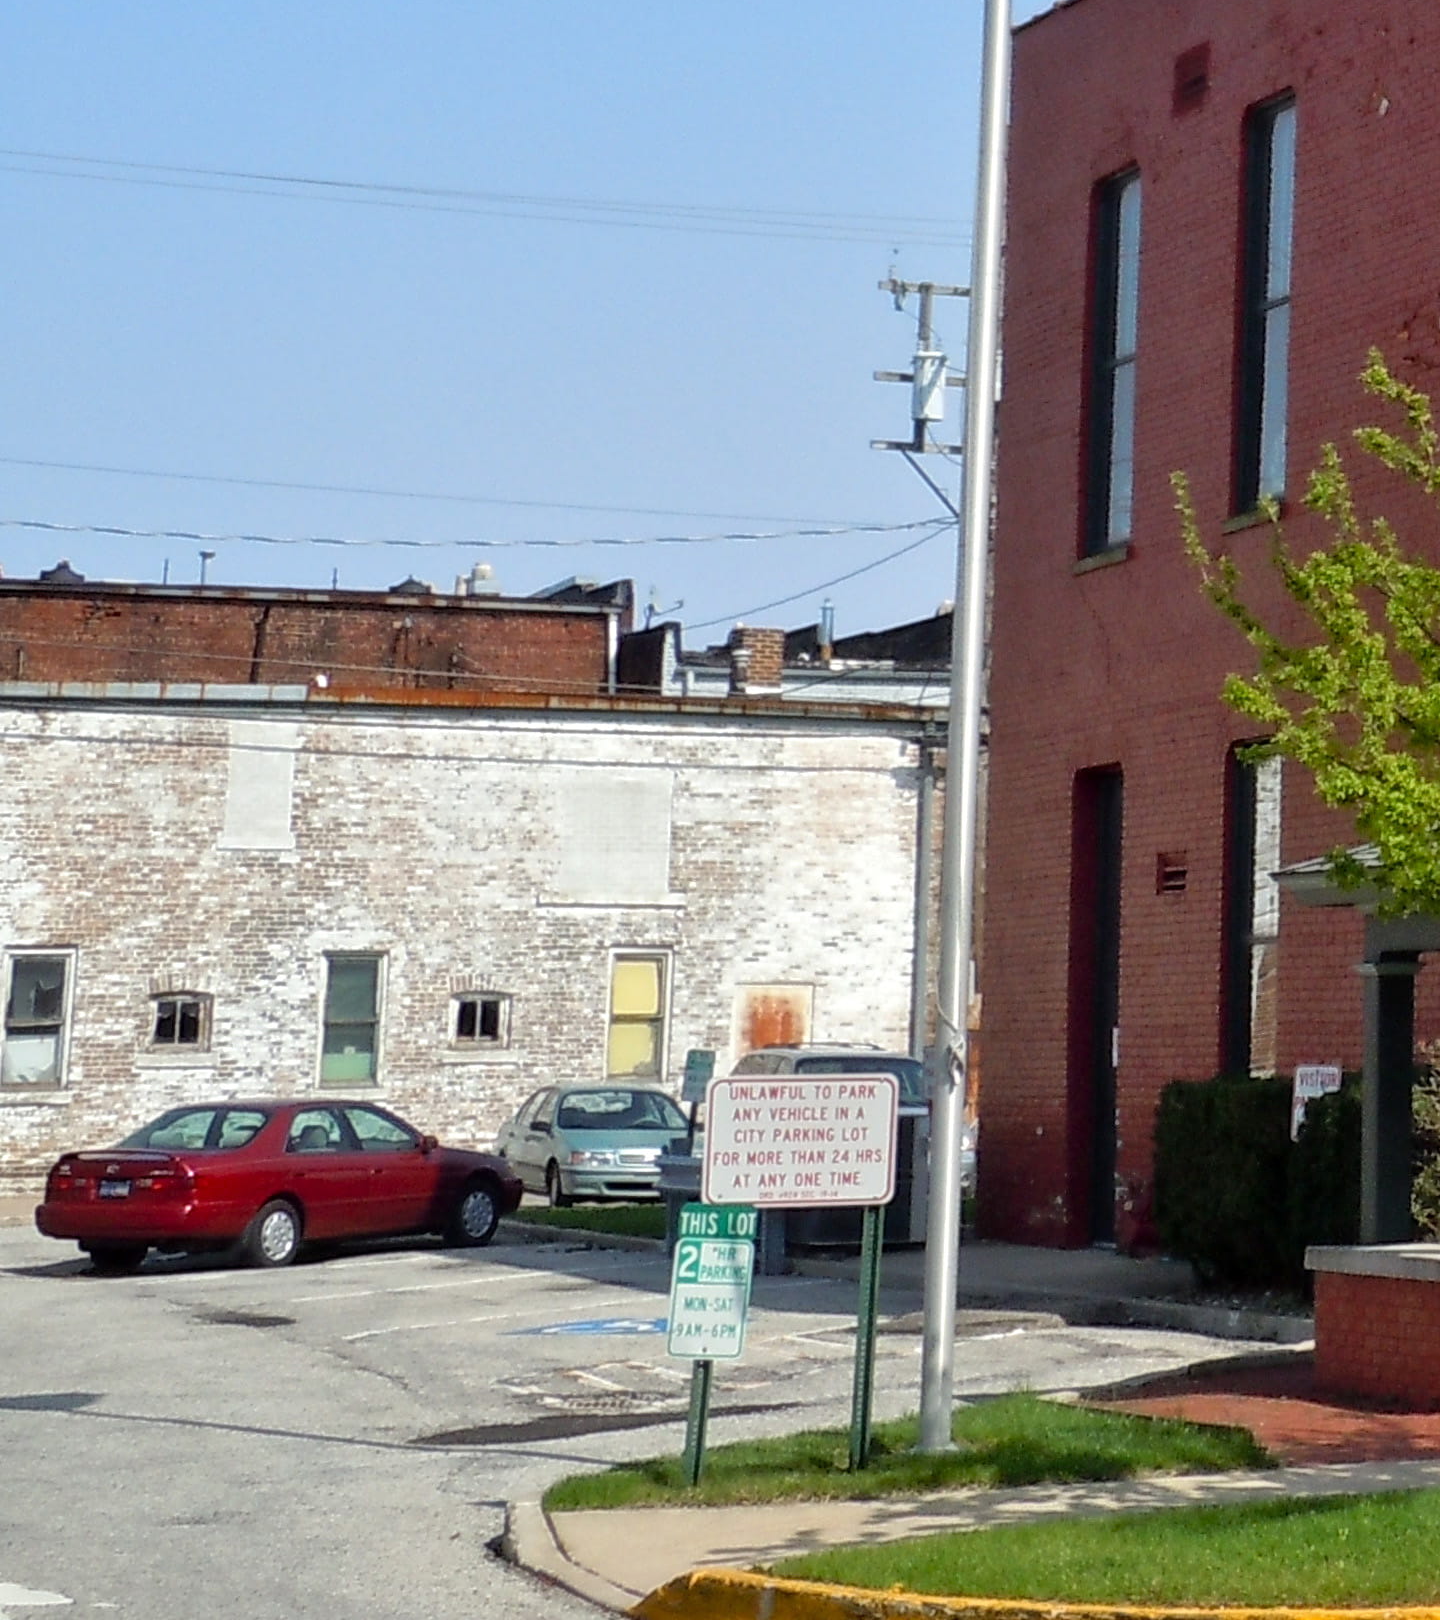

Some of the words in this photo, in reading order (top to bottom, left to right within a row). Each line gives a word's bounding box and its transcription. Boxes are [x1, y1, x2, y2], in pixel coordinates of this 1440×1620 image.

[729, 1085, 807, 1101] UNLAWFUL
[815, 1085, 831, 1099] TO
[838, 1084, 877, 1099] PARK
[732, 1108, 761, 1122] ANY
[769, 1107, 827, 1121] VEHICLE
[835, 1107, 849, 1120] IN
[856, 1106, 865, 1120] A
[734, 1130, 765, 1144] CITY
[773, 1128, 835, 1143] PARKING
[842, 1127, 869, 1141] LOT
[713, 1152, 740, 1166] FOR
[747, 1151, 783, 1165] MORE
[791, 1150, 825, 1165] THAN
[832, 1149, 849, 1164] 24
[856, 1149, 883, 1163] HRS
[733, 1175, 750, 1188] AT
[758, 1174, 787, 1187] ANY
[794, 1172, 821, 1187] ONE
[830, 1172, 861, 1186] TIME
[680, 1212, 719, 1235] THIS
[727, 1212, 757, 1236] LOT
[678, 1245, 698, 1278] 2
[717, 1246, 737, 1260] HR
[700, 1265, 747, 1280] PARKING
